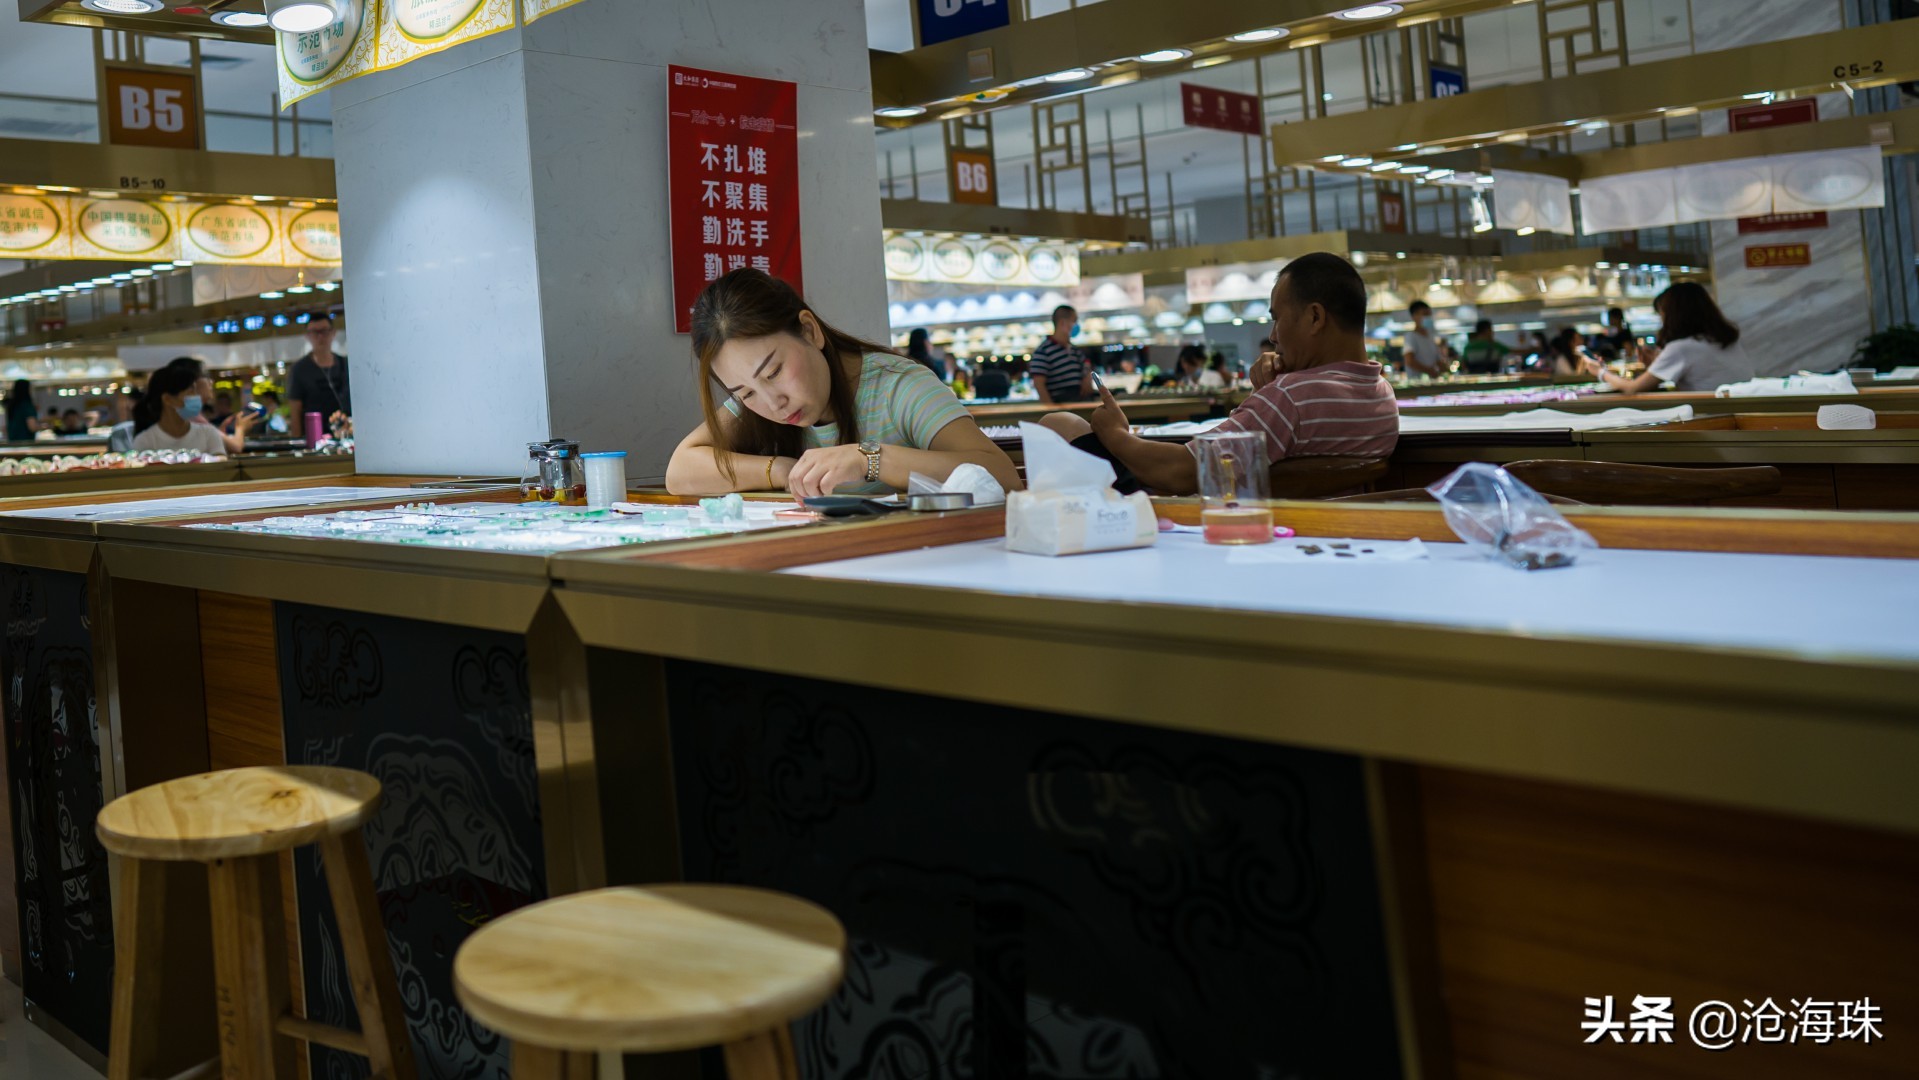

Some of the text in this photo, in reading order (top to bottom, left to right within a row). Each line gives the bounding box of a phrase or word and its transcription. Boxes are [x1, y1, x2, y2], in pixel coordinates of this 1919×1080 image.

[1833, 60, 1884, 79] C5-2
[119, 85, 184, 133] B5
[700, 142, 767, 175] 不扎堆
[120, 176, 166, 190] B5-10
[957, 161, 987, 193] B6
[701, 180, 768, 212] 不聚集
[0, 207, 44, 220] 省诚信
[702, 215, 769, 247] 勤洗手
